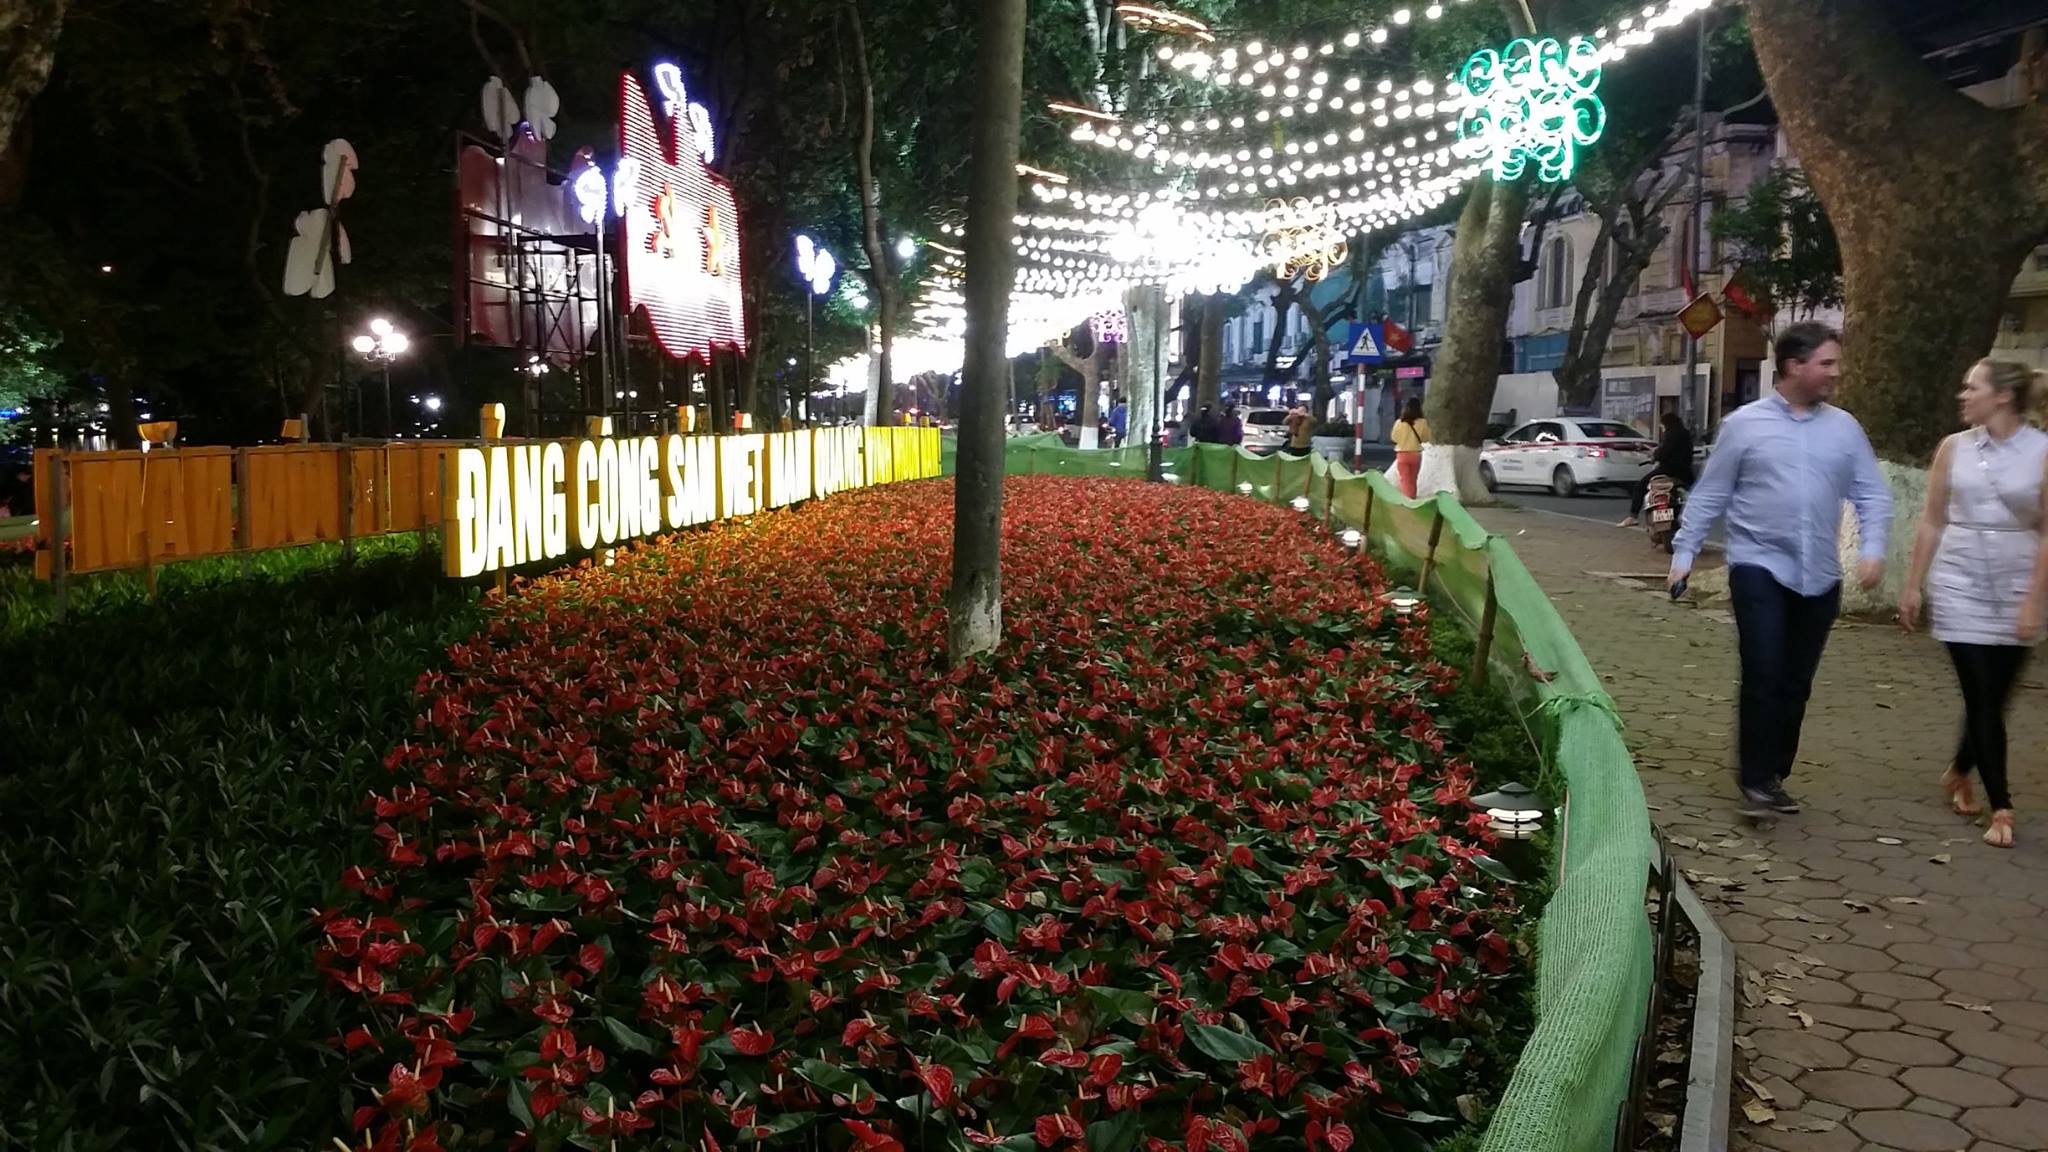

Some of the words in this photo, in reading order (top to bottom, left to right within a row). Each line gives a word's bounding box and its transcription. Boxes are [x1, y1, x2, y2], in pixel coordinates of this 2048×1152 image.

[457, 404, 566, 577] ĐẢNG
[578, 417, 660, 565] CỘNG
[668, 405, 716, 528] SẢN
[770, 429, 811, 508] NAM
[814, 425, 863, 500] QUANG
